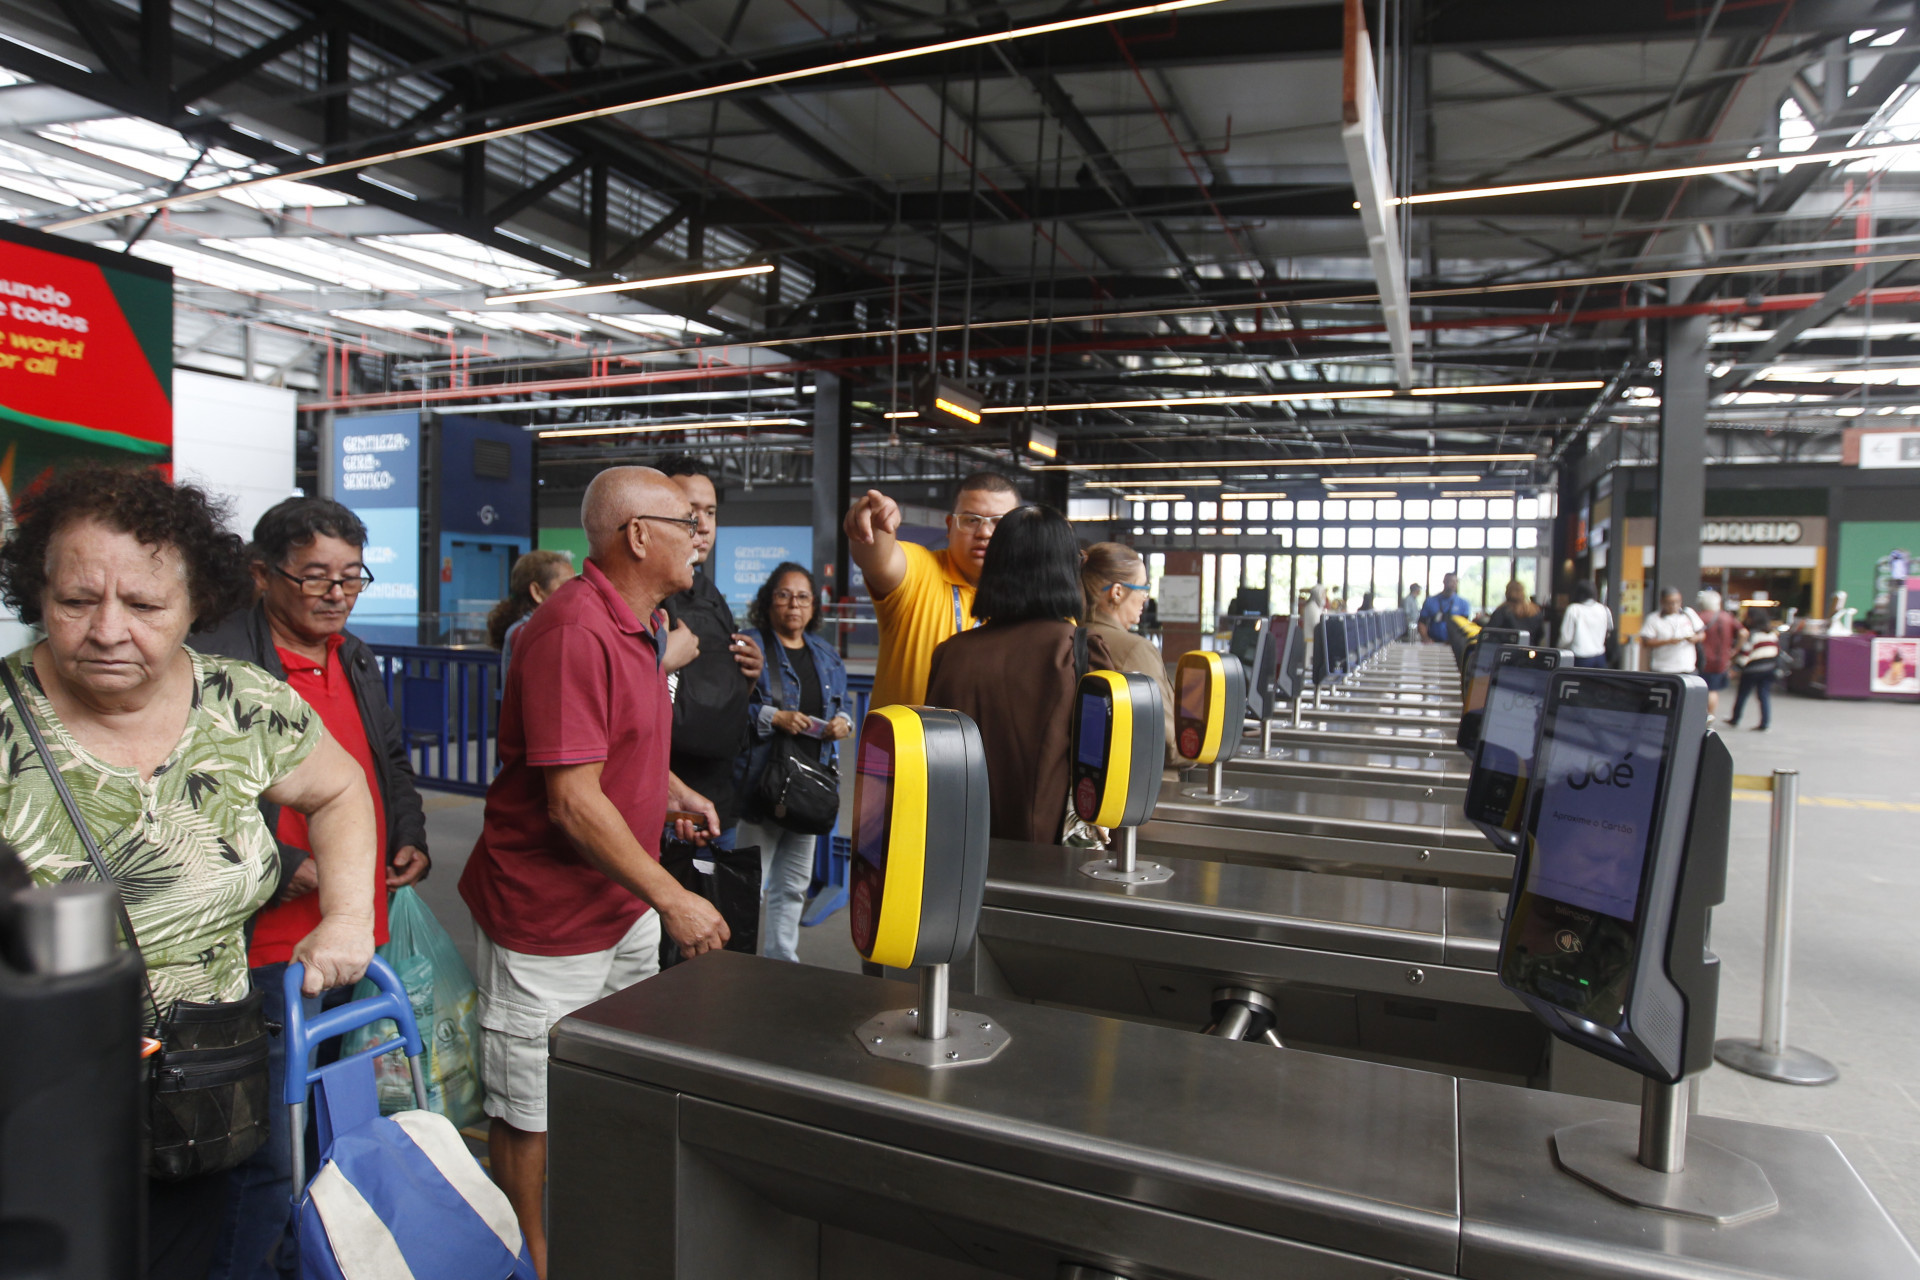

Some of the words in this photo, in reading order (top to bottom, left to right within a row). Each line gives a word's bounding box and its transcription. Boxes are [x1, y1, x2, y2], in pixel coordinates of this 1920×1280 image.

[0, 280, 71, 307] undo
[10, 301, 89, 332] todos
[10, 332, 84, 359] world
[25, 356, 58, 376] all
